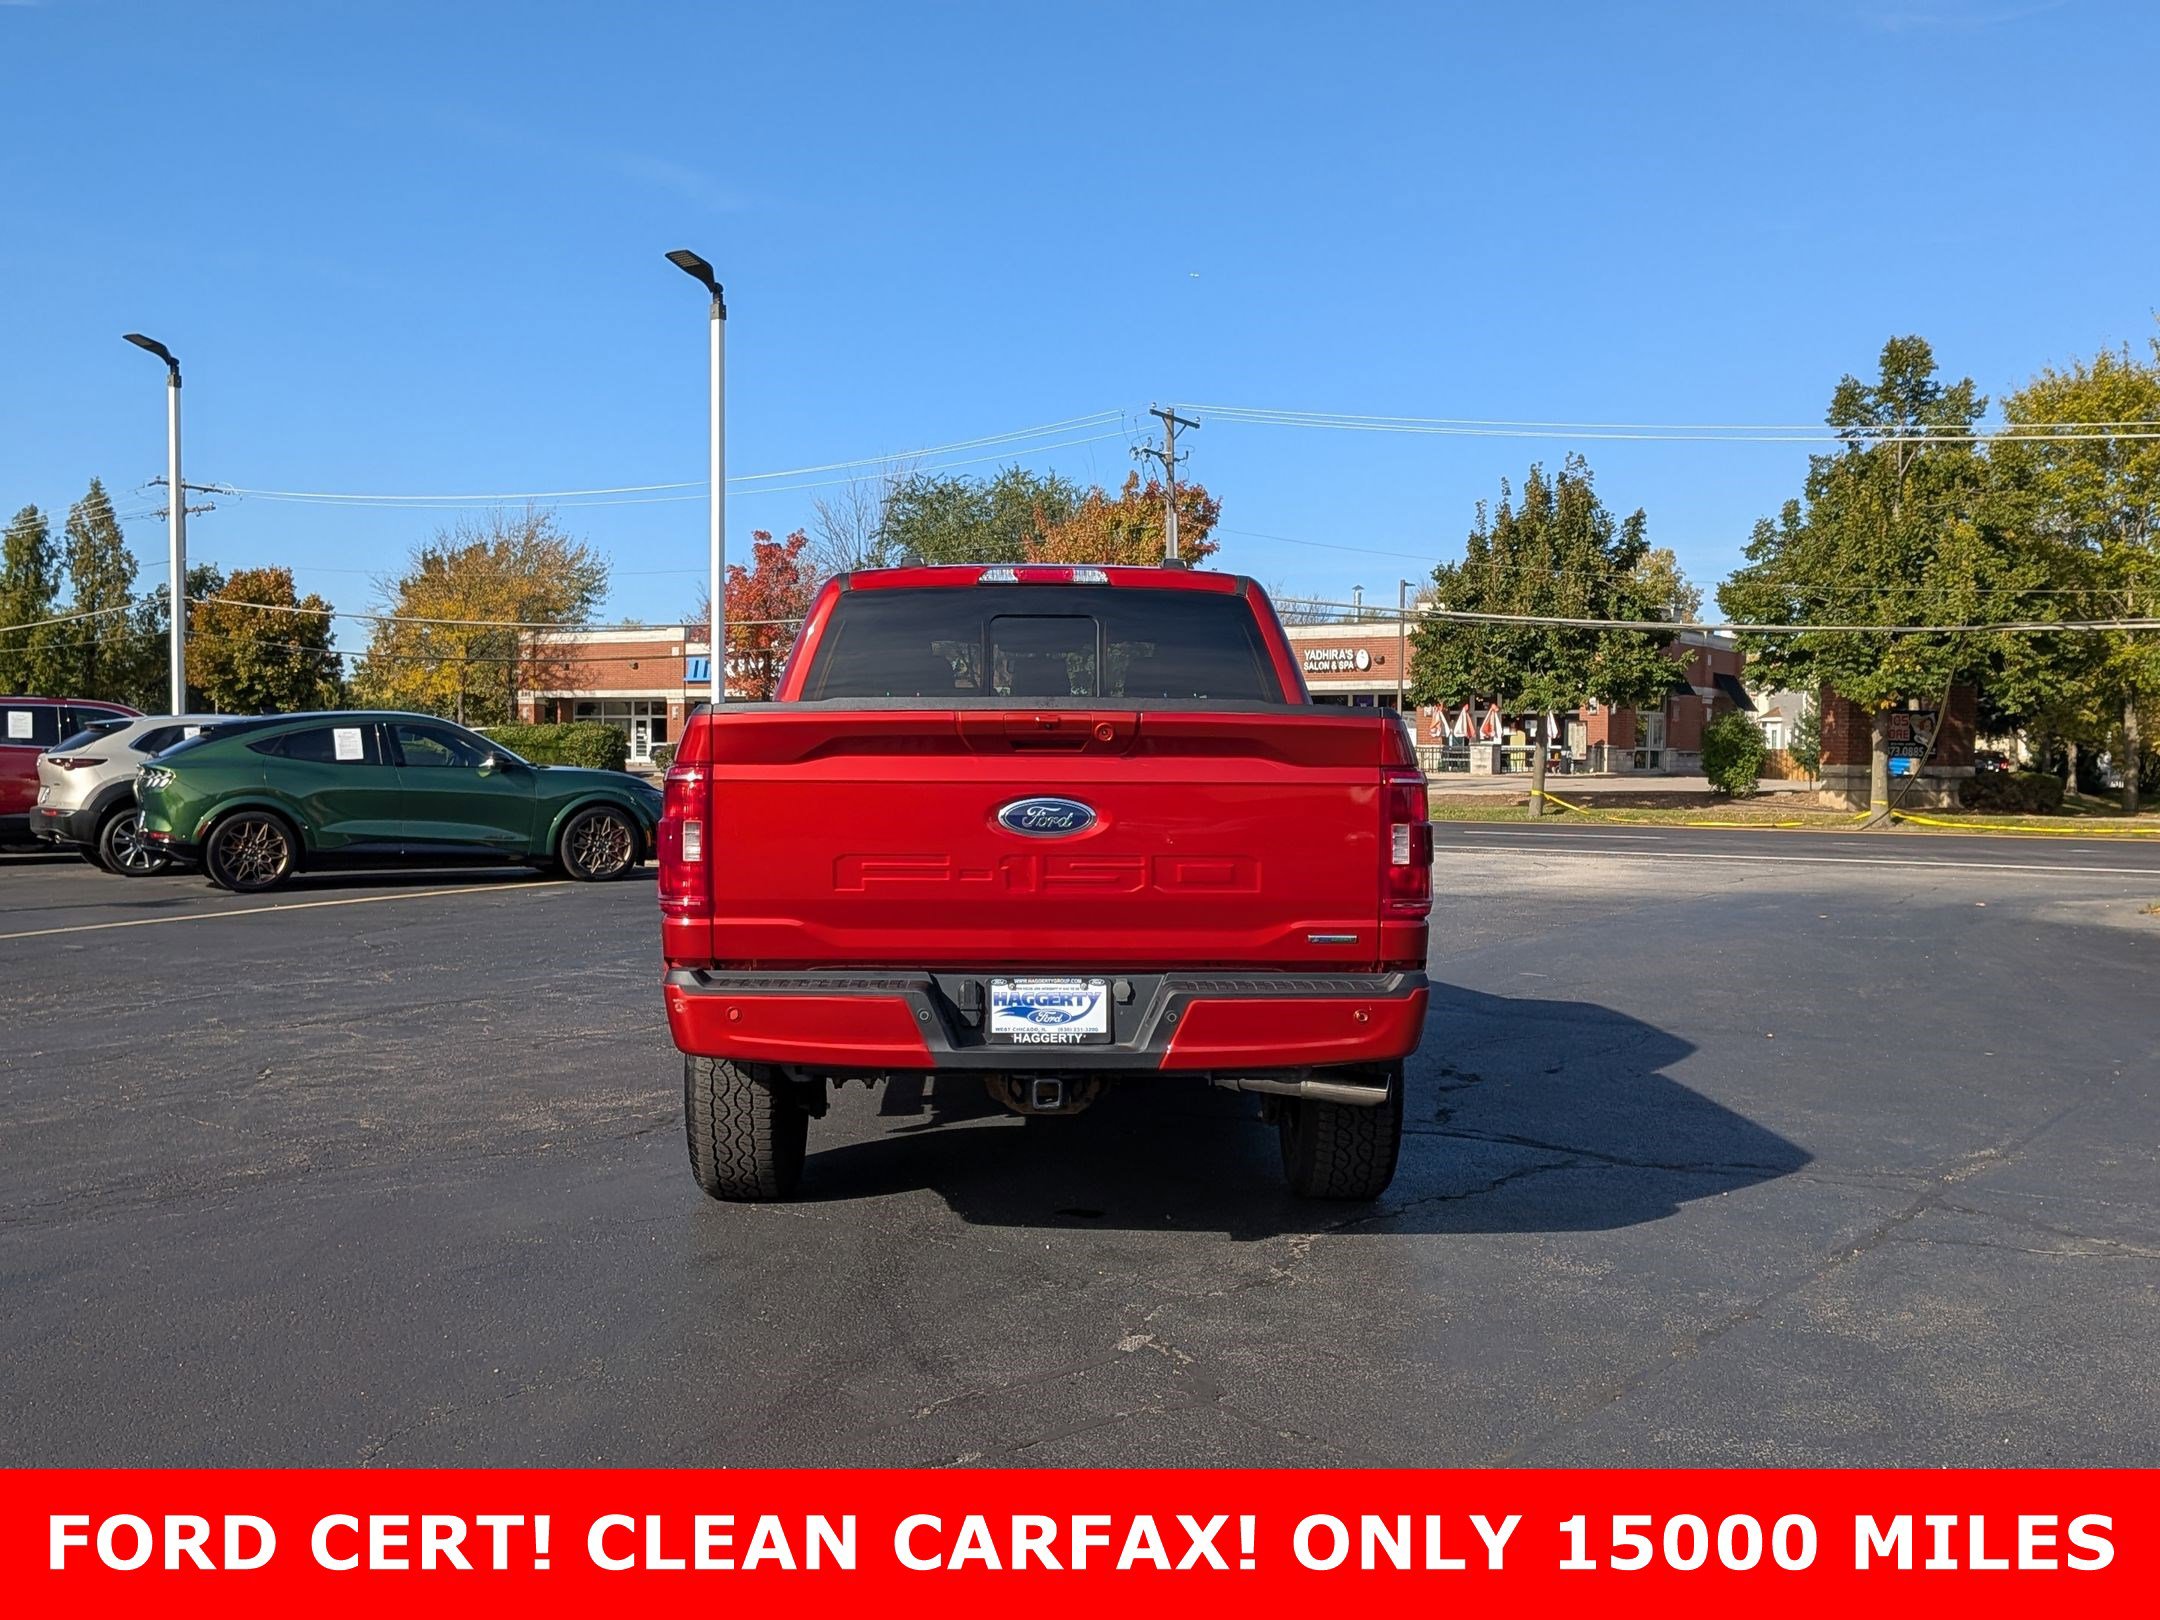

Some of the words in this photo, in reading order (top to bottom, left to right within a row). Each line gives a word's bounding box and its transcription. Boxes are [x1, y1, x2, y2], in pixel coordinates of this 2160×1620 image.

[1304, 649, 1354, 660] YADHIRA'S
[1304, 661, 1330, 670] SALON
[1331, 662, 1337, 670] &
[1339, 661, 1354, 670] SPA
[1022, 806, 1074, 828] Ford
[832, 853, 1262, 893] F-150
[993, 991, 1102, 1007] HAGGERTY
[1035, 1009, 1063, 1024] Ford
